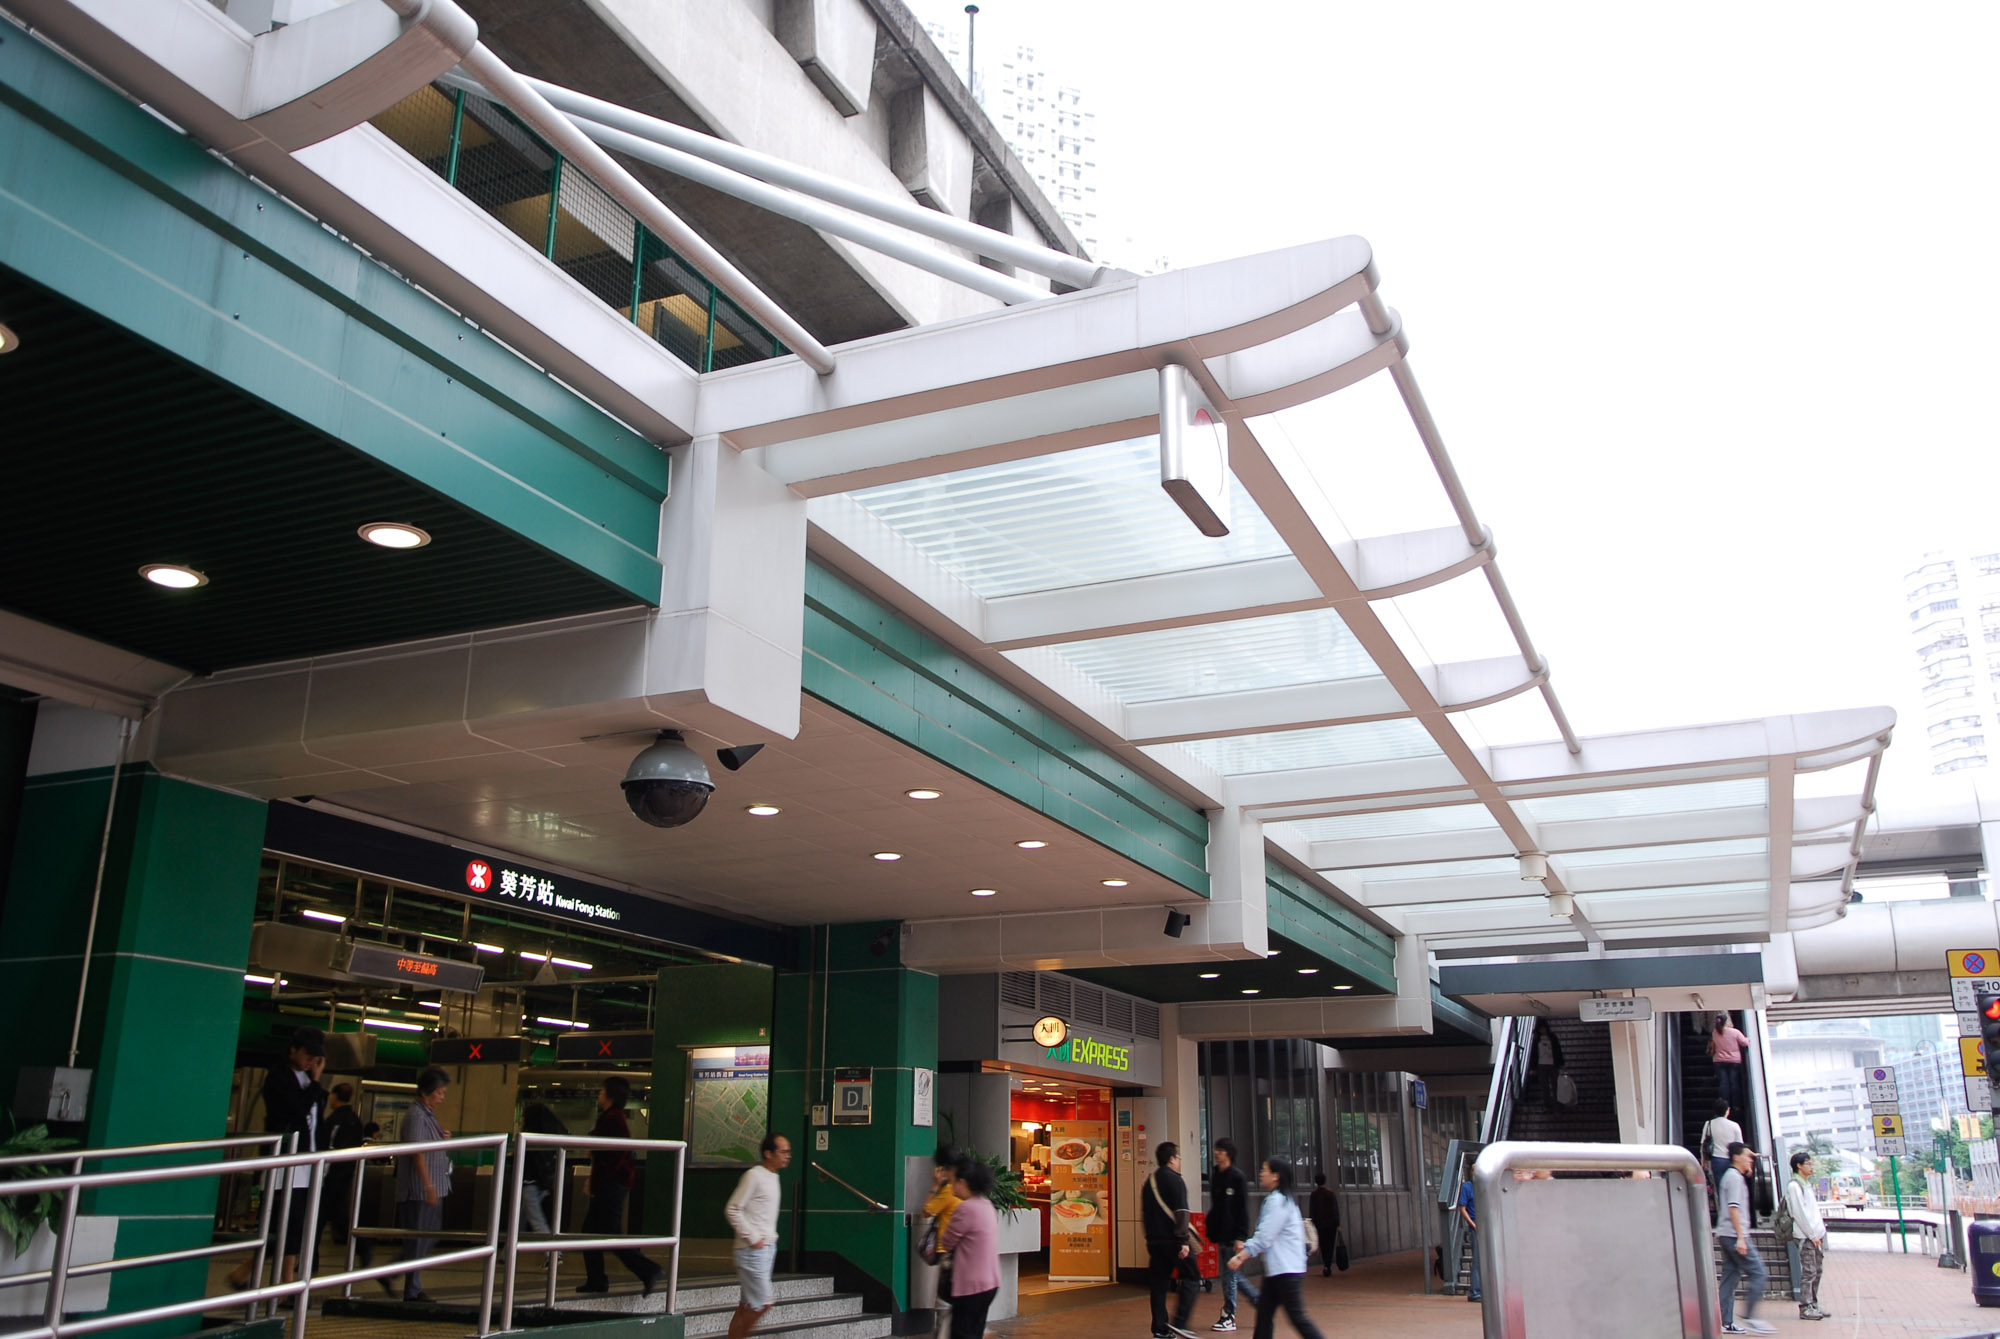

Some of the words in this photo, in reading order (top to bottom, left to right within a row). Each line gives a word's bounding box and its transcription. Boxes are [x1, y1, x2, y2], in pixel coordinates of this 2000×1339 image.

[500, 869, 555, 906] 葵芳站
[555, 895, 575, 910] Kwai
[575, 899, 595, 917] Fong
[595, 904, 620, 920] Station
[1072, 1036, 1129, 1071] EXPRESS
[848, 1090, 859, 1107] D
